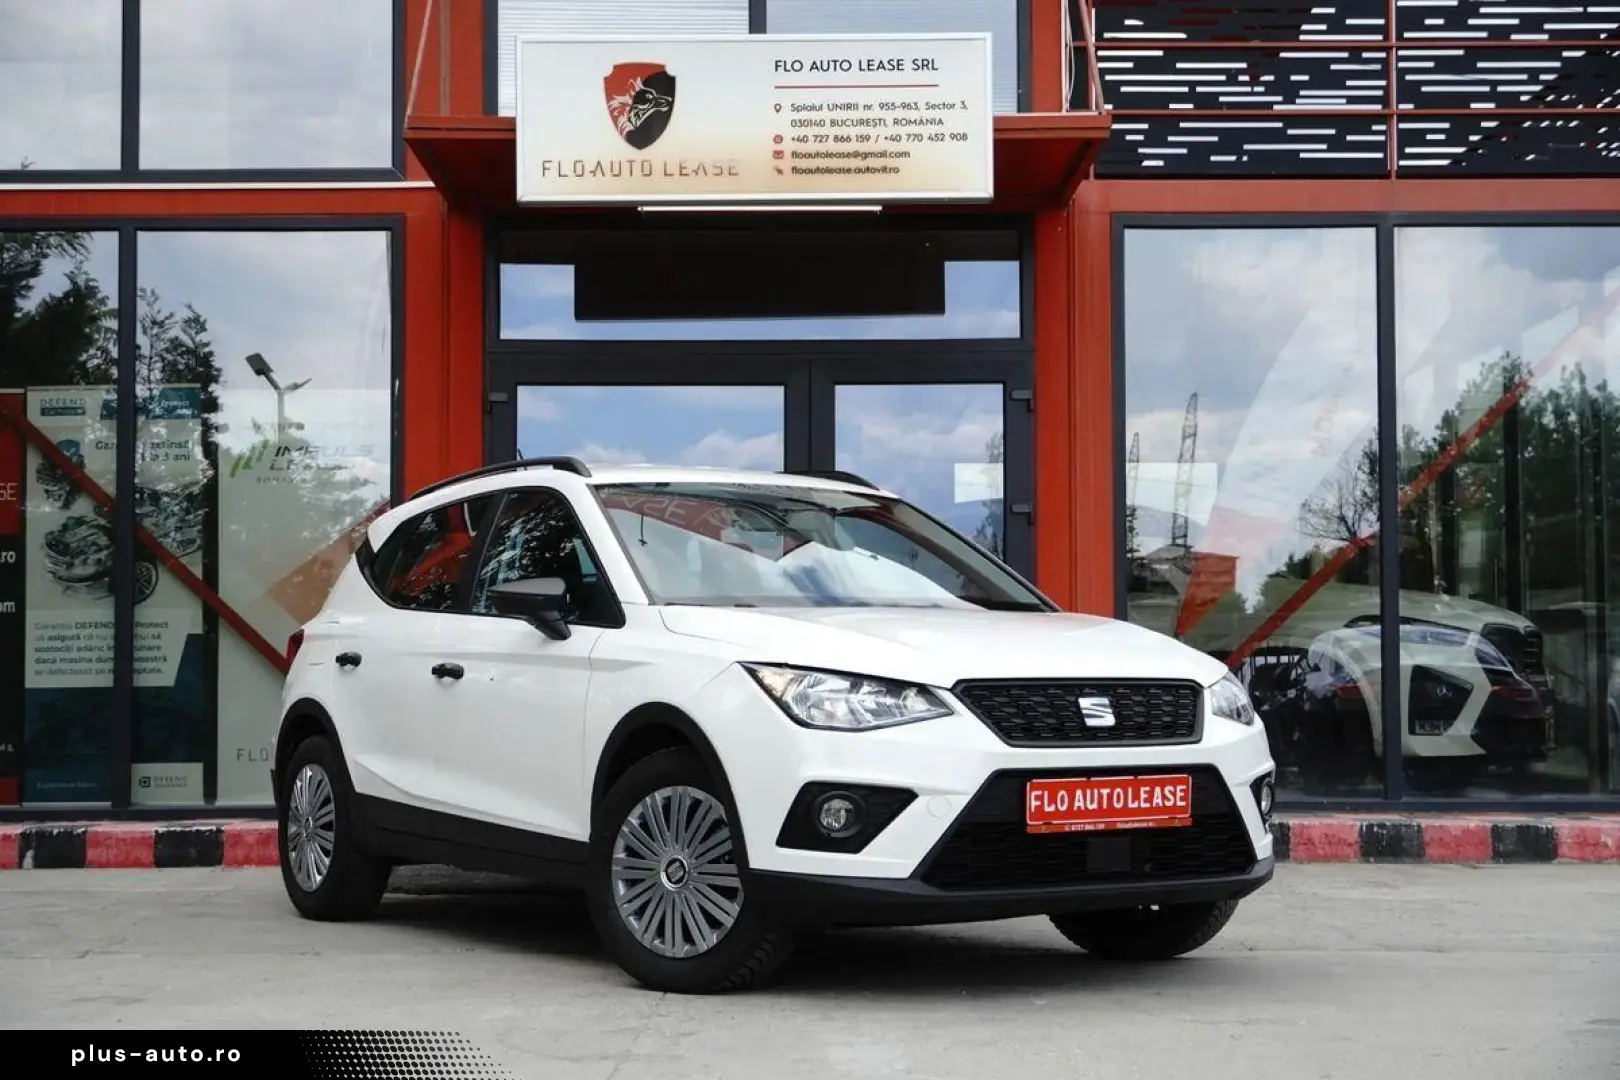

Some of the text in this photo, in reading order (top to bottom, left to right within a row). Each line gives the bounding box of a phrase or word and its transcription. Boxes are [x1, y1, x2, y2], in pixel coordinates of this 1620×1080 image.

[774, 57, 939, 73] FLO AUTO LEASE SRL
[790, 102, 823, 114] Splaiul
[827, 102, 859, 112] UNIRII
[878, 101, 921, 112] 955-963,
[924, 101, 956, 111] Sector
[959, 100, 969, 111] 3,
[790, 118, 826, 128] 030140
[893, 115, 945, 127] ROMÂNIA
[791, 134, 809, 144] +40
[812, 134, 830, 144] 727
[833, 134, 851, 143] 866
[855, 133, 871, 143] 159
[884, 133, 902, 143] +40
[905, 133, 923, 142] 770
[927, 132, 946, 142] 452
[949, 132, 969, 141] 908
[790, 149, 911, 161] floautolease@gmail.com
[663, 159, 739, 177] LEASE
[790, 165, 900, 176] floautolease.autovit.ro
[1031, 785, 1187, 813] FLO AUTO LEASE
